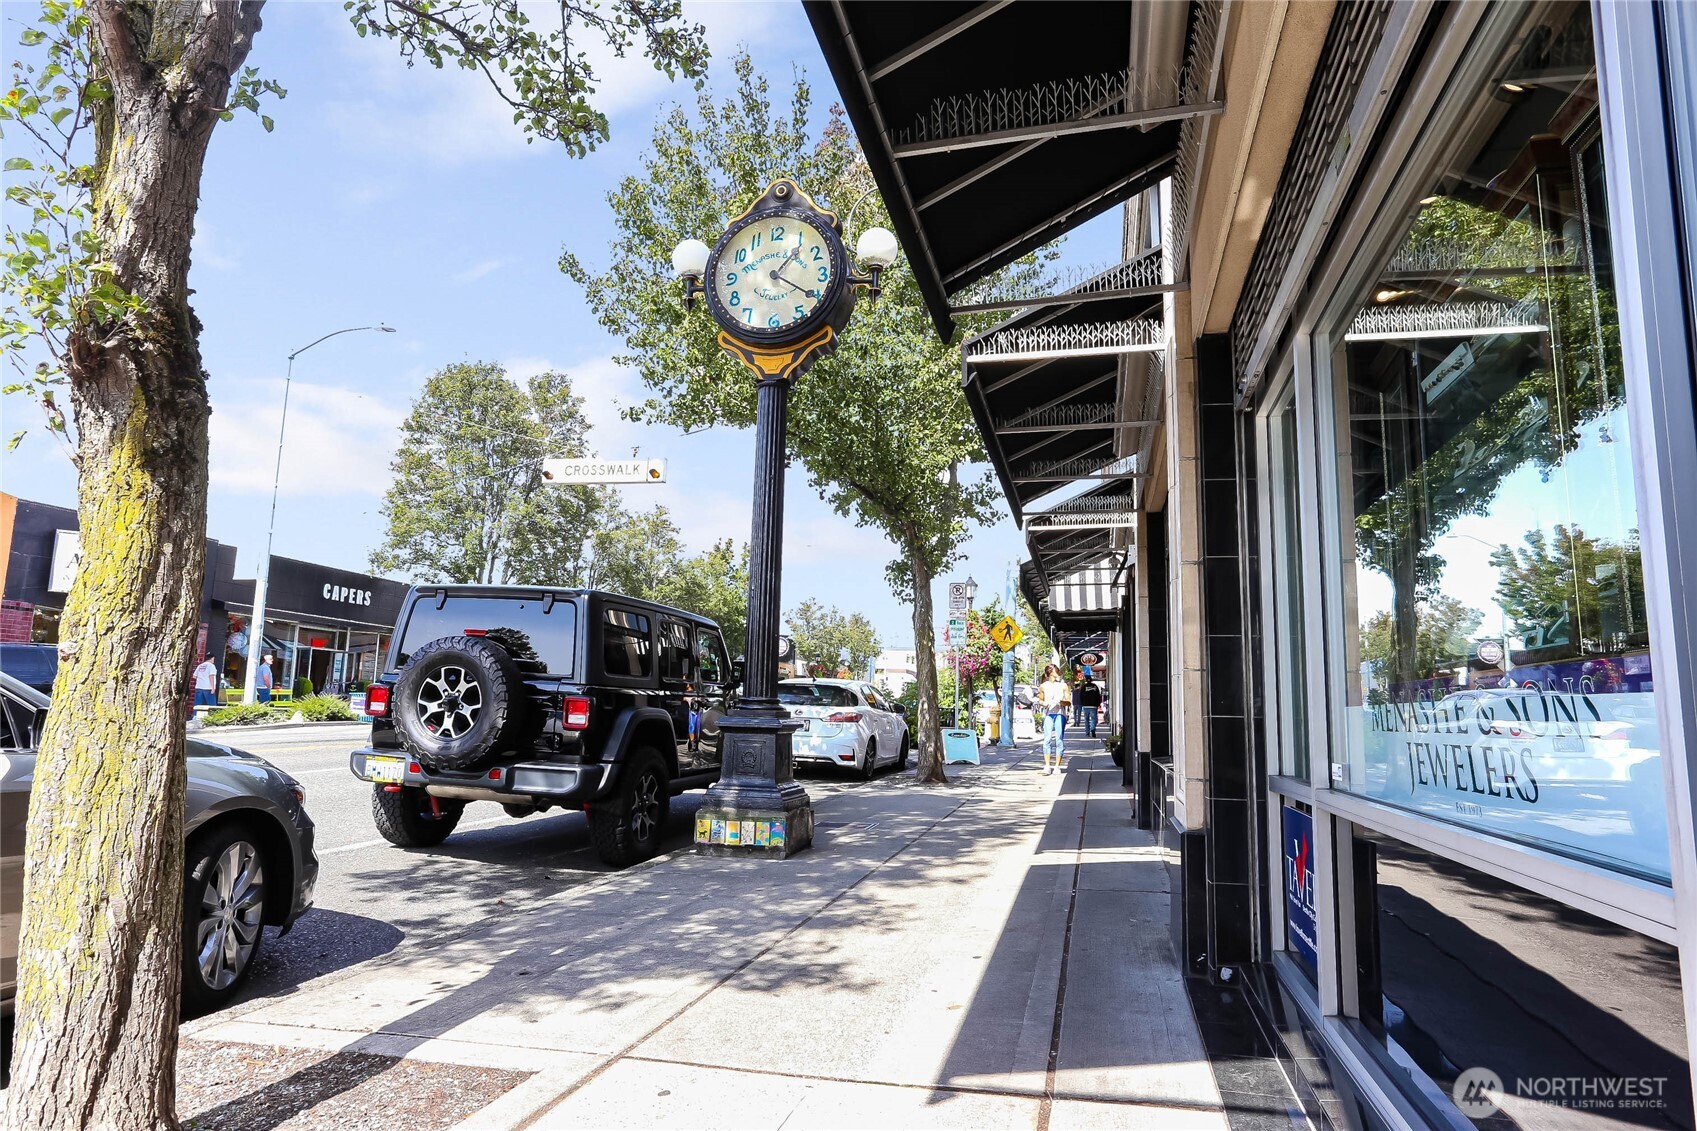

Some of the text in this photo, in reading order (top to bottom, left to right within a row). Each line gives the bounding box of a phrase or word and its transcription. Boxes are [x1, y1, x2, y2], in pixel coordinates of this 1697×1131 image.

[751, 232, 761, 251] 11
[770, 226, 785, 242] 12
[798, 231, 803, 246] 1
[734, 247, 747, 265] 10
[810, 245, 824, 261] 2
[725, 272, 738, 286] 9
[817, 266, 829, 283] 3
[729, 290, 741, 307] 8
[742, 307, 753, 324] 7
[768, 313, 781, 328] 6
[792, 304, 805, 321] 5
[564, 464, 641, 476] CROSSWALK
[322, 583, 372, 607] CAPERS
[1371, 686, 1469, 735] MENASHE
[1406, 741, 1540, 804] JEWELERS
